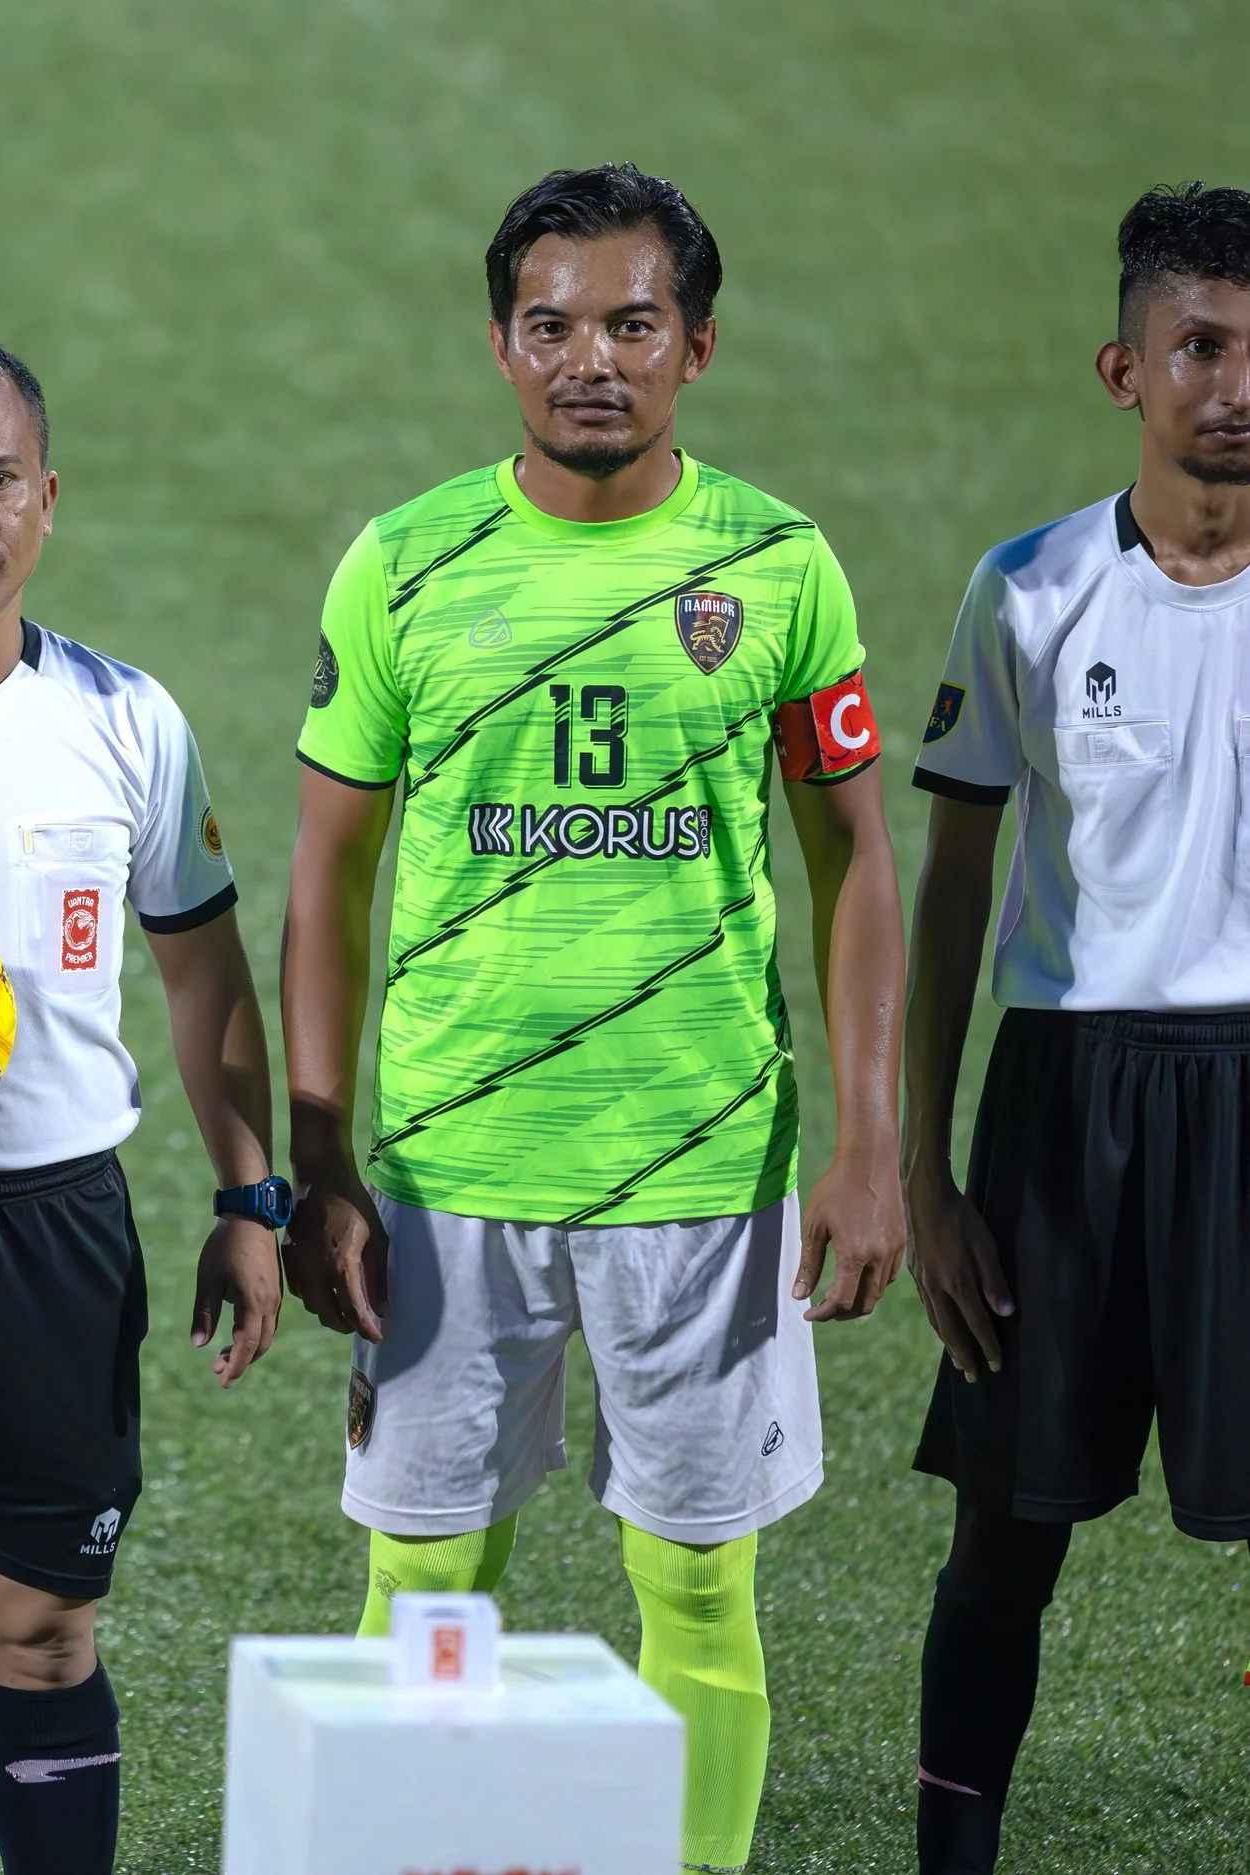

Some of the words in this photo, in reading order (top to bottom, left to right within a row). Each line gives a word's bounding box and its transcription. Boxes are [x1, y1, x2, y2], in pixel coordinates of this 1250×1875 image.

[684, 598, 735, 617] NAMHOR
[830, 693, 870, 750] C
[1082, 705, 1122, 718] MILLS
[549, 684, 628, 789] 13
[524, 807, 700, 856] KORUS
[699, 809, 709, 854] GROUP
[65, 952, 94, 964] PREMIER
[79, 1541, 117, 1555] MILLS
